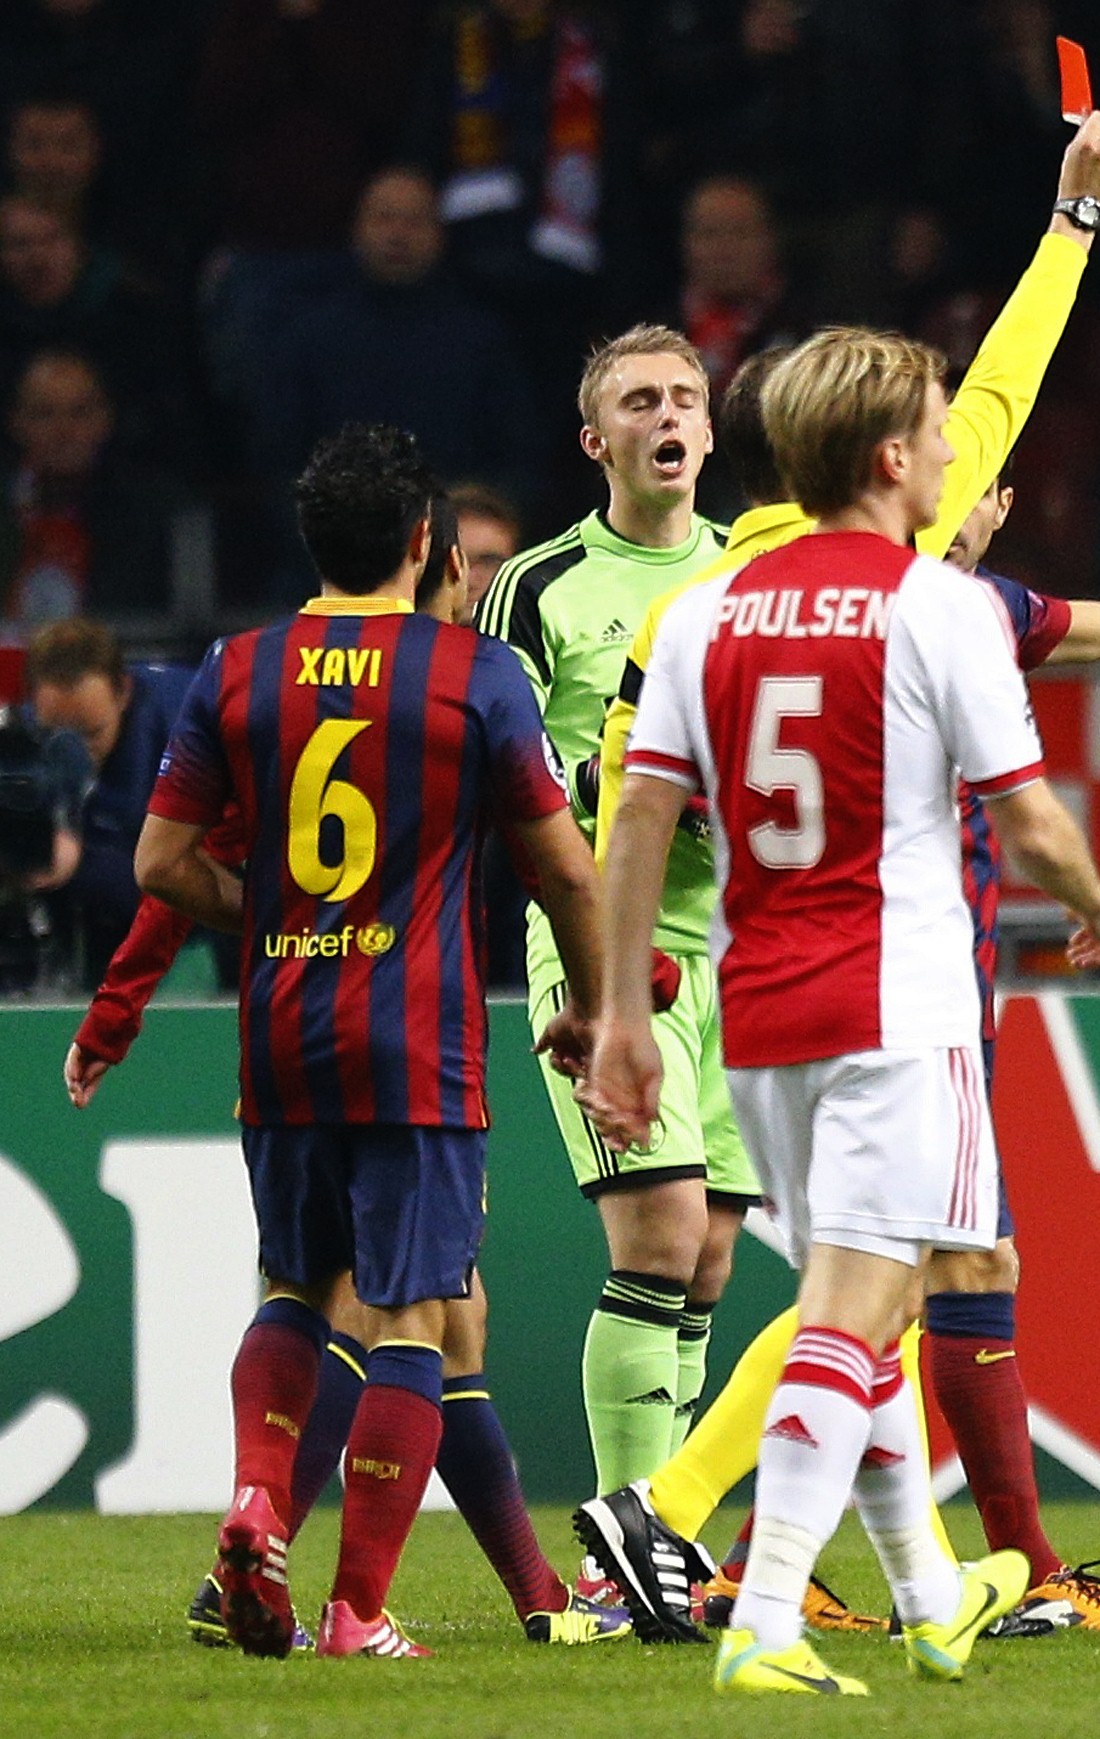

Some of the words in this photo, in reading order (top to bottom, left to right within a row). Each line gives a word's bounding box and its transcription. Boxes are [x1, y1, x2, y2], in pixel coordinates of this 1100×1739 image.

[710, 586, 895, 642] POULSEN
[296, 648, 382, 688] XAVI
[745, 676, 826, 869] 5
[288, 718, 377, 902] 6
[264, 926, 354, 958] unicef
